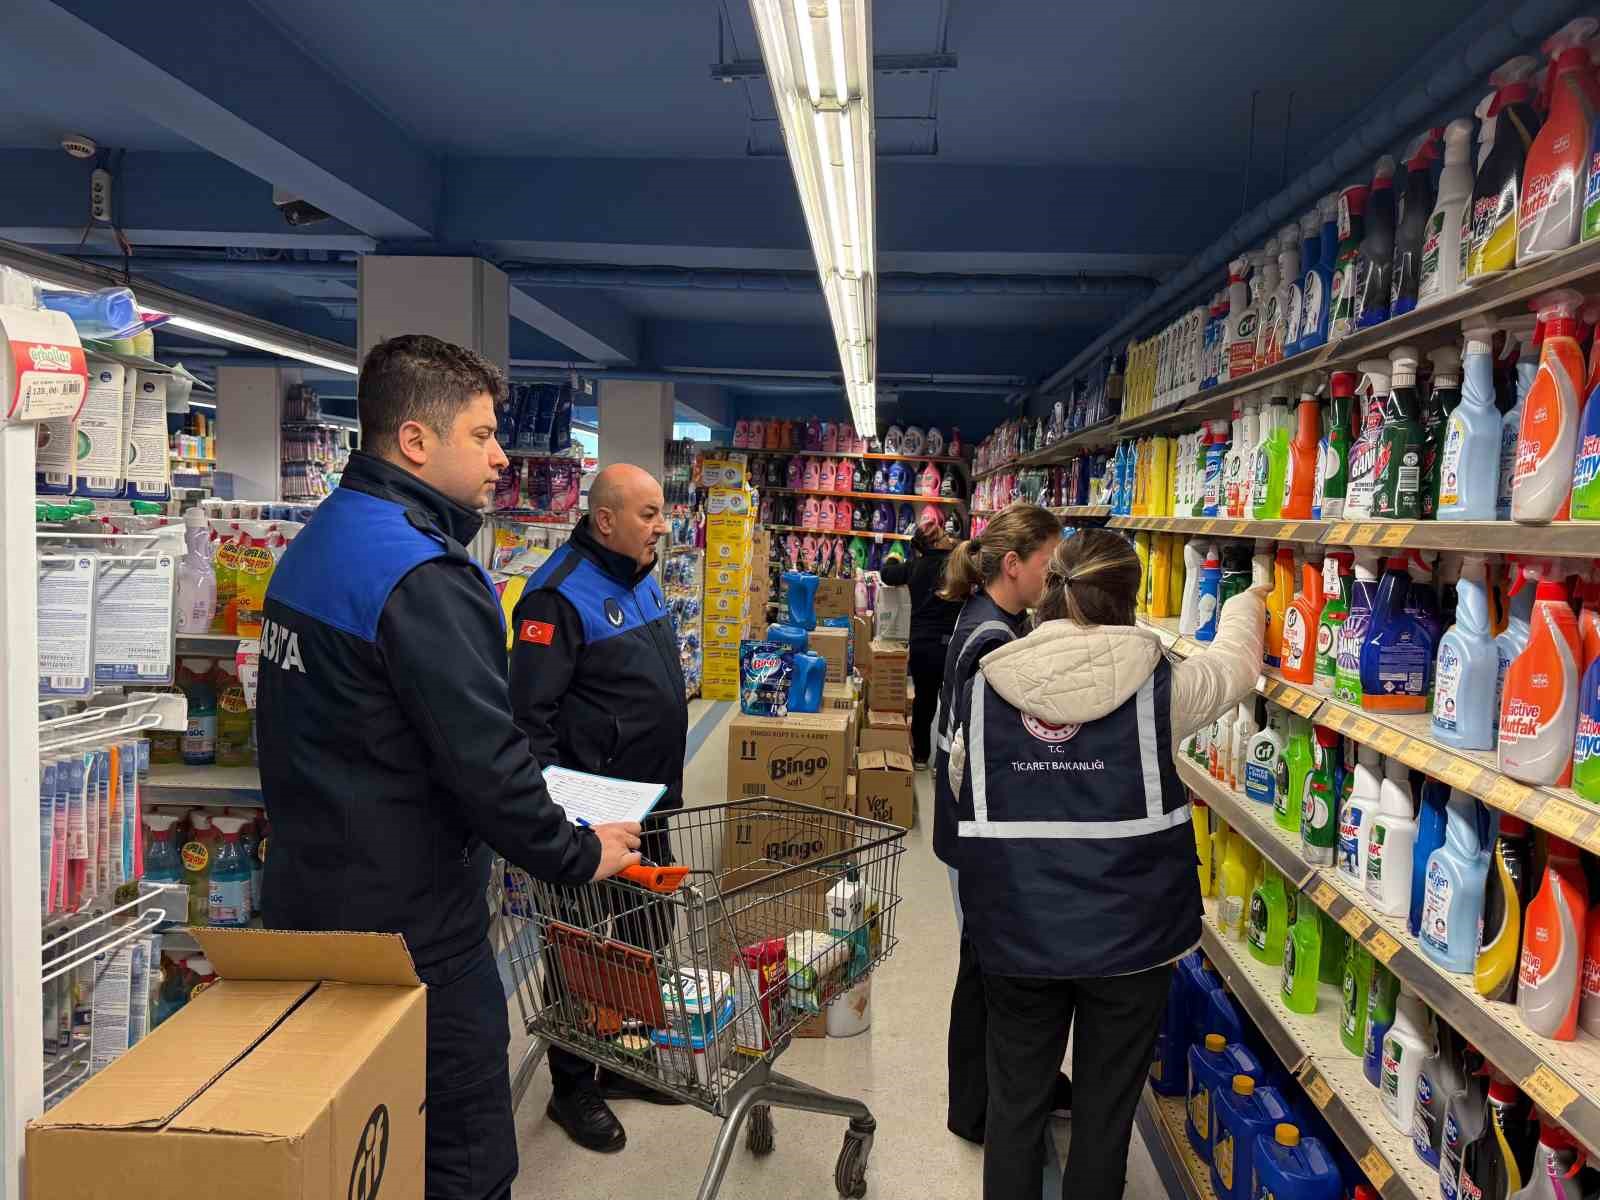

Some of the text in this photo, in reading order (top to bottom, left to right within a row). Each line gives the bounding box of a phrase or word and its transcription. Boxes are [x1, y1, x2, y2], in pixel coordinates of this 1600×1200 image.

[1048, 745, 1065, 753] T.C.
[770, 757, 828, 780] Bingo
[1011, 759, 1105, 772] TİCARET BAKANLIĞI
